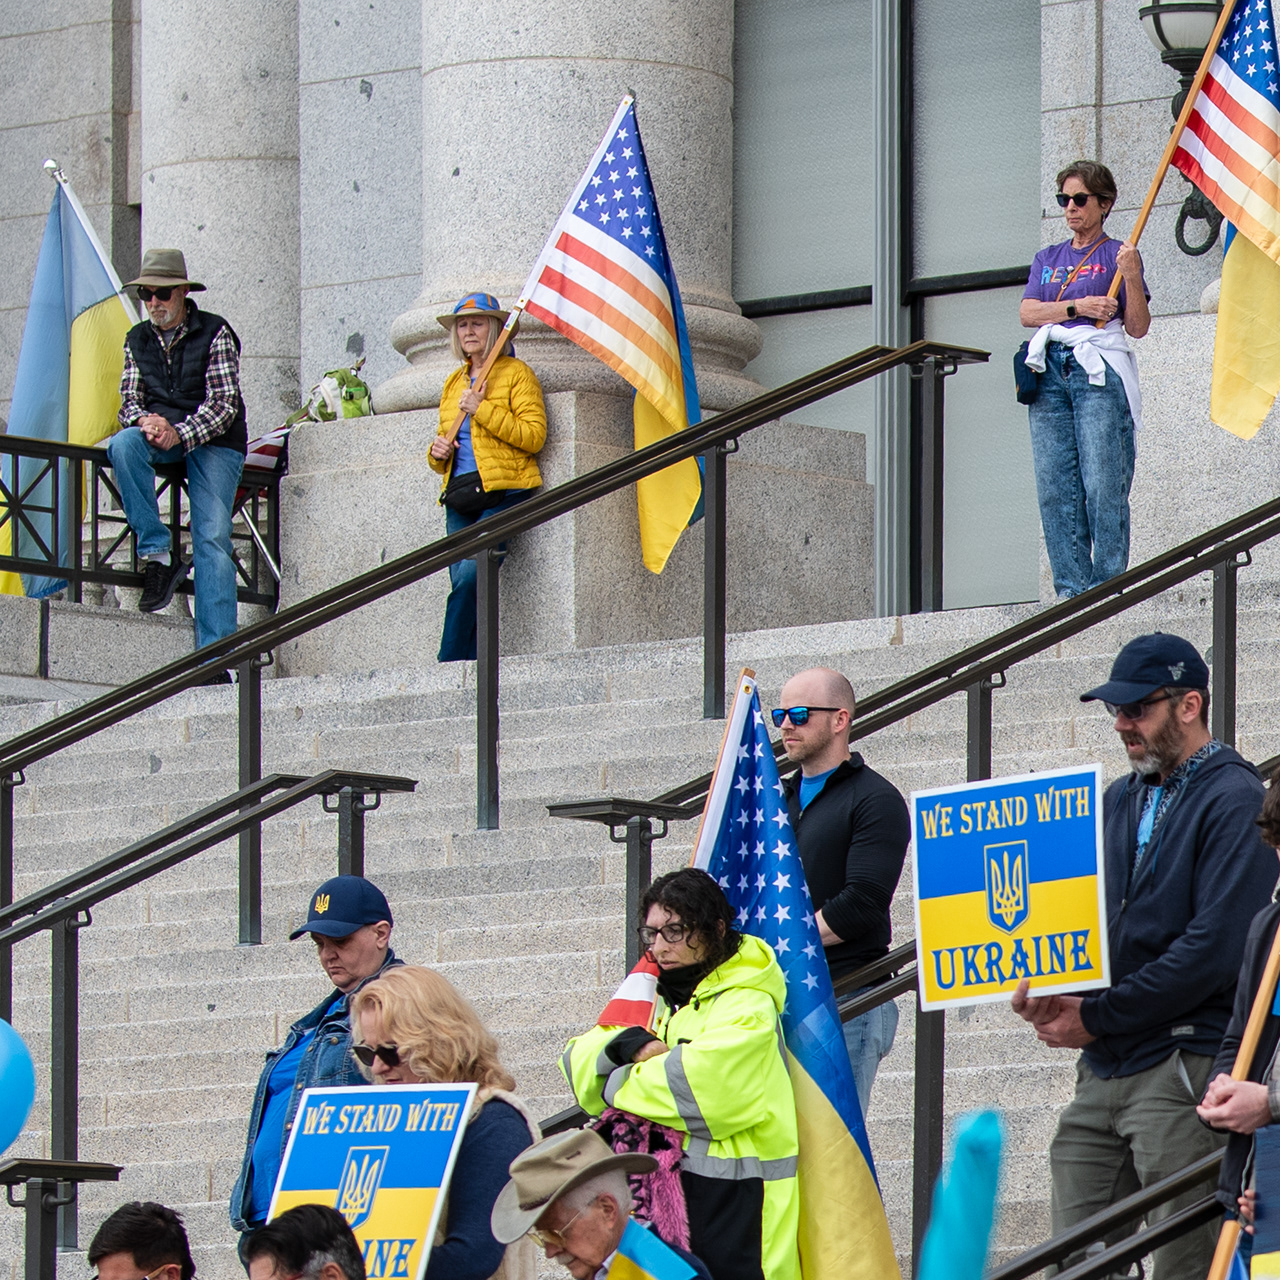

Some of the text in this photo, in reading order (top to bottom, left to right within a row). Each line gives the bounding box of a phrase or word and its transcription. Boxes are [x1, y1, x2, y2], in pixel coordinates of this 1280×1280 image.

[921, 785, 1090, 840] WE STAND WITH
[931, 929, 1094, 990] UKRAINE
[302, 1098, 460, 1135] WE STAND WITH
